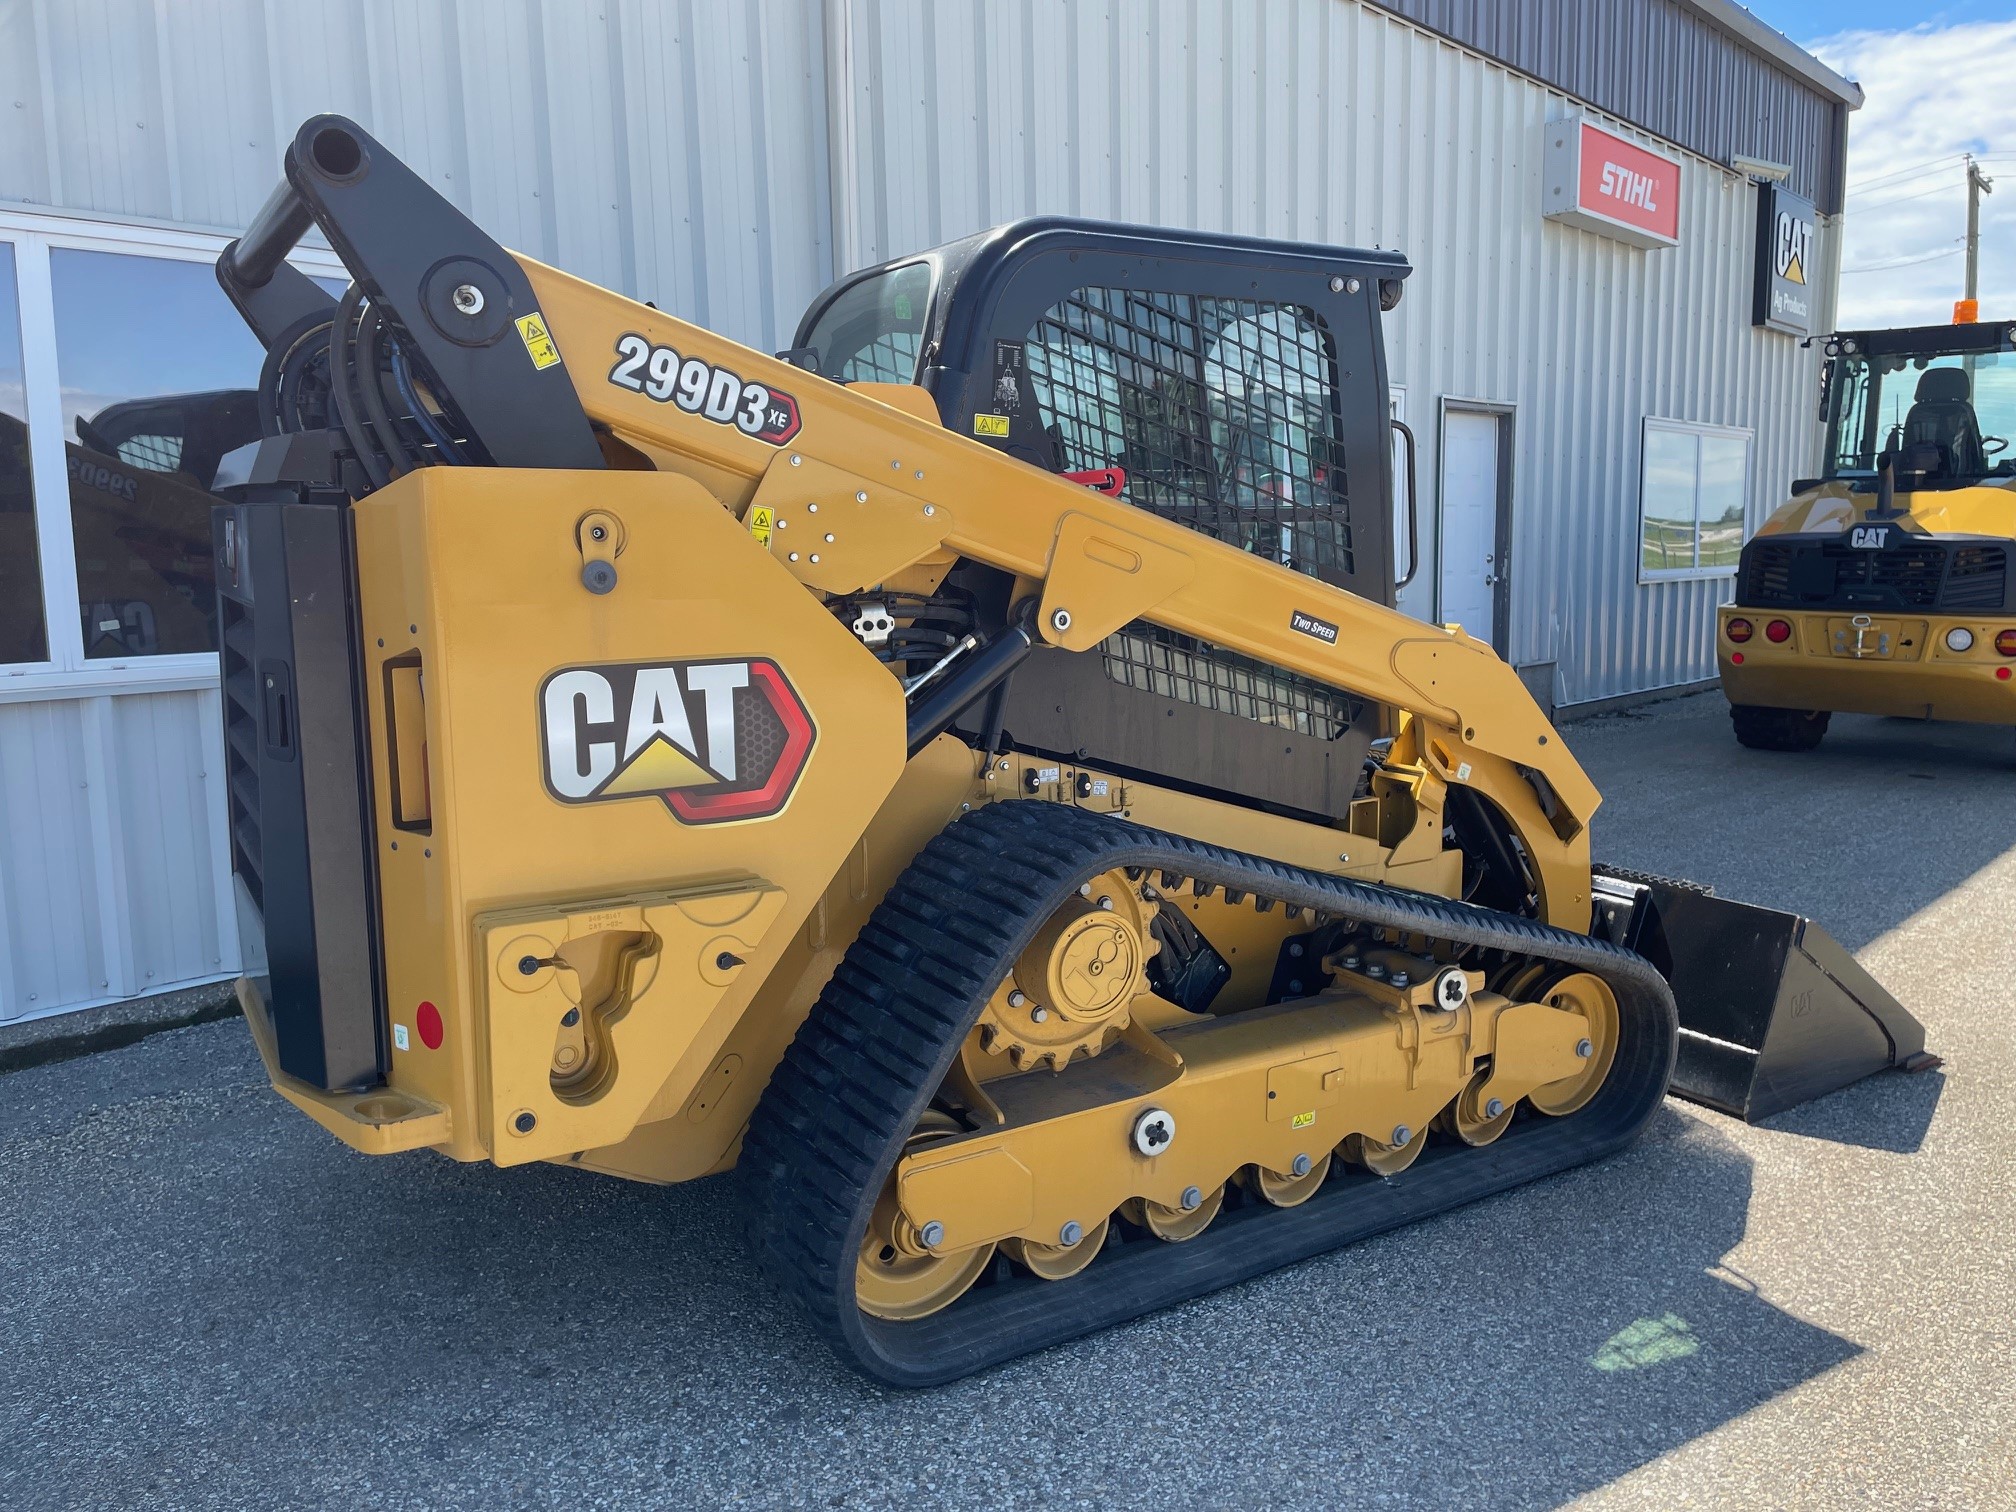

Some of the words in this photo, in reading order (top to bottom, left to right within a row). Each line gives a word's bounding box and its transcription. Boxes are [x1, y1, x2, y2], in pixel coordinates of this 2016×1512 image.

[1600, 161, 1656, 212] STIHL
[1776, 212, 1813, 285] CAT
[1773, 290, 1783, 313] Ag
[1783, 293, 1807, 317] Products
[611, 336, 769, 433] 299D3
[767, 409, 788, 428] XE
[1851, 527, 1889, 548] CAT
[545, 662, 749, 798] CAT
